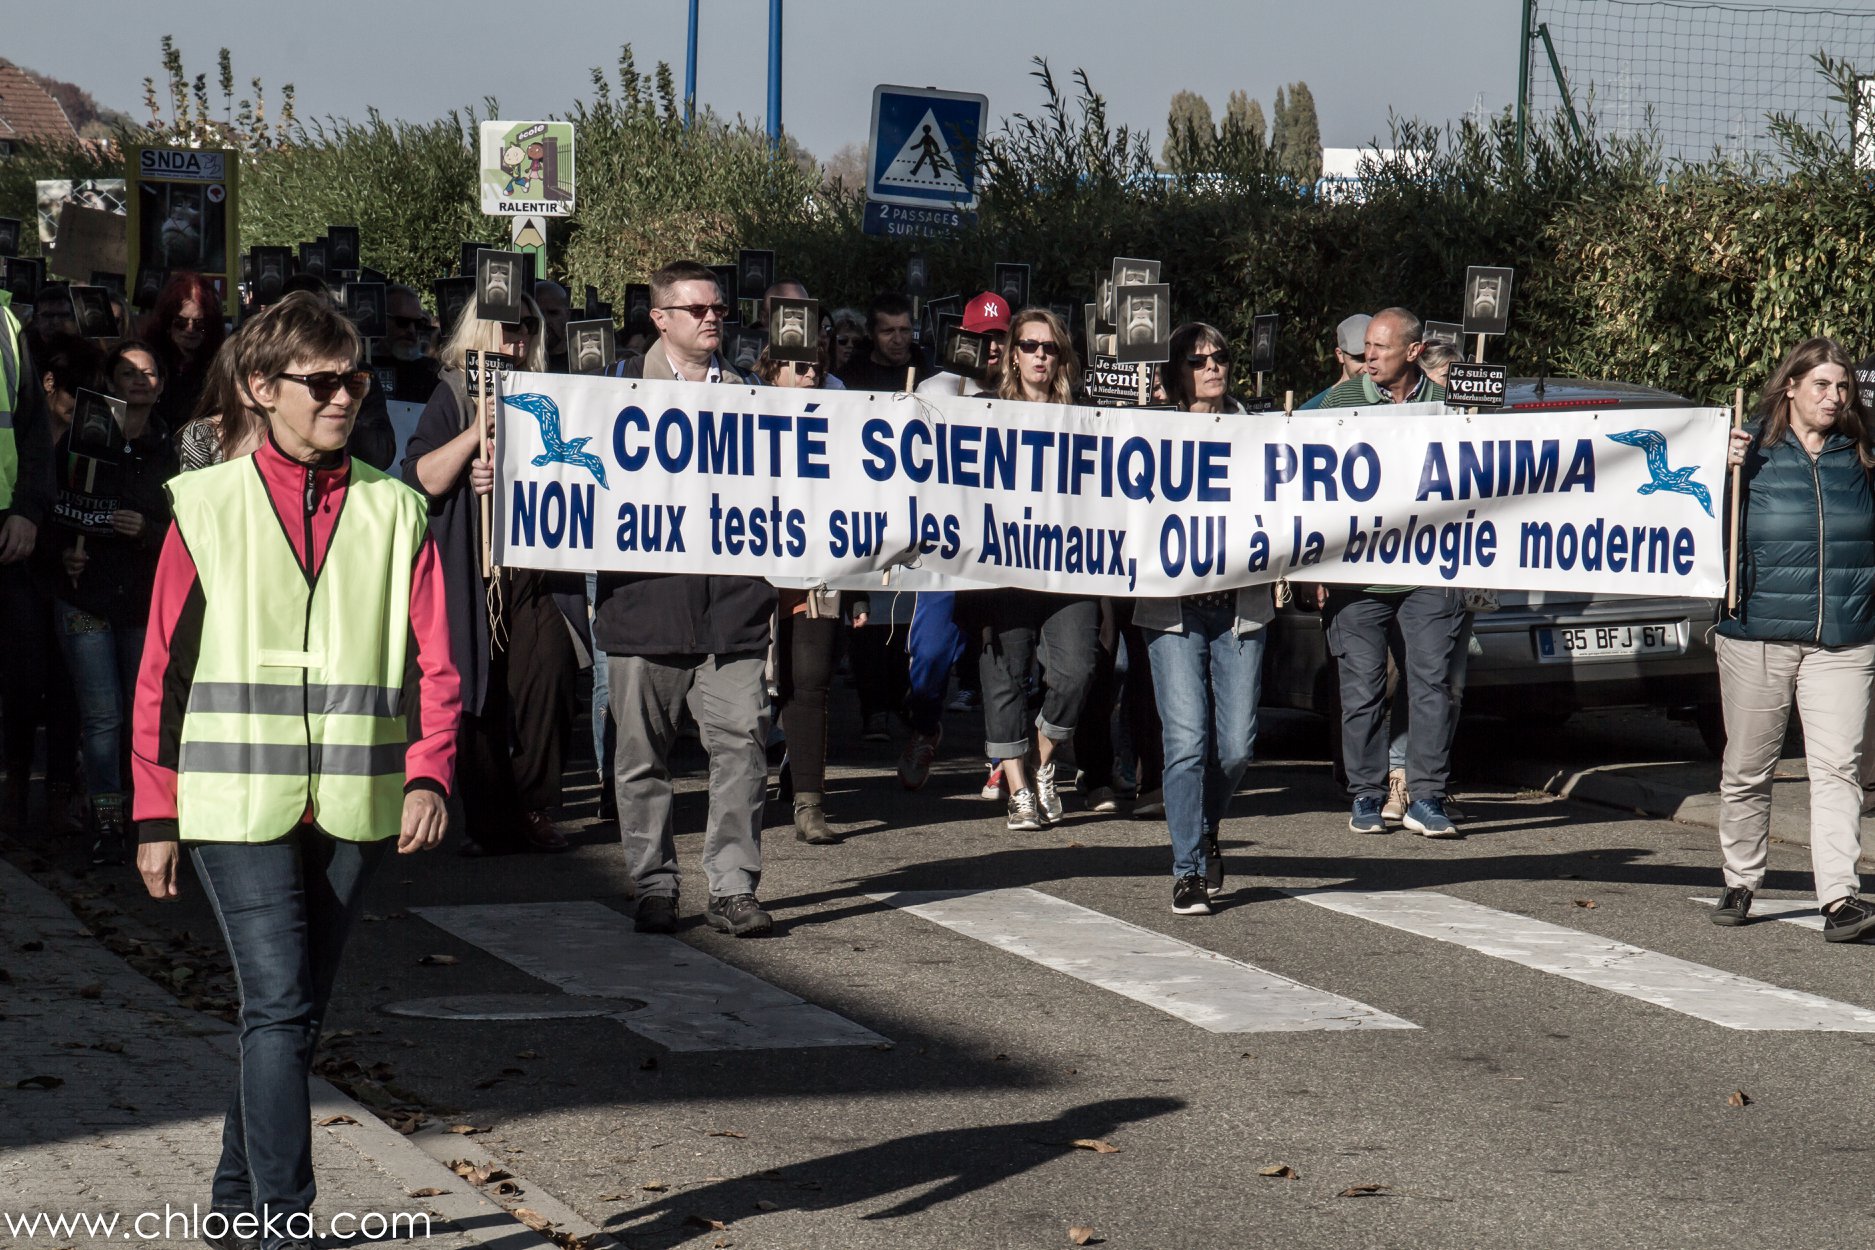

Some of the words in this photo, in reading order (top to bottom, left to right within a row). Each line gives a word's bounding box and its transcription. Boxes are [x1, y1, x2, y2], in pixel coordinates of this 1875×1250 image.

[518, 125, 545, 140] école
[141, 150, 201, 170] SNDA
[499, 202, 557, 212] RALENTIR
[879, 204, 889, 218] 2
[893, 208, 959, 226] PASSAGES
[1097, 359, 1110, 370] Je
[1451, 366, 1465, 377] Je
[1466, 368, 1488, 378] suis
[1489, 371, 1504, 379] en
[1450, 379, 1503, 394] vente
[613, 403, 830, 480] COMITÉ
[861, 418, 1231, 504] SCIENTIFIQUE
[1265, 442, 1381, 503] PRO
[1416, 440, 1595, 503] ANIMA
[59, 489, 118, 510] JUSTICE
[511, 481, 596, 549] NON
[616, 503, 686, 553] aux
[709, 493, 807, 559] tests
[829, 506, 888, 559] sur
[908, 496, 961, 559] les
[979, 503, 1136, 592] Animaux,
[1160, 514, 1226, 578] OUI
[1249, 515, 1269, 573] à
[1289, 515, 1322, 566] la
[1342, 510, 1497, 580] biologie
[1520, 518, 1695, 576] moderne
[1561, 630, 1587, 650] 35
[1595, 628, 1633, 649] BFJ
[1642, 626, 1666, 647] 67
